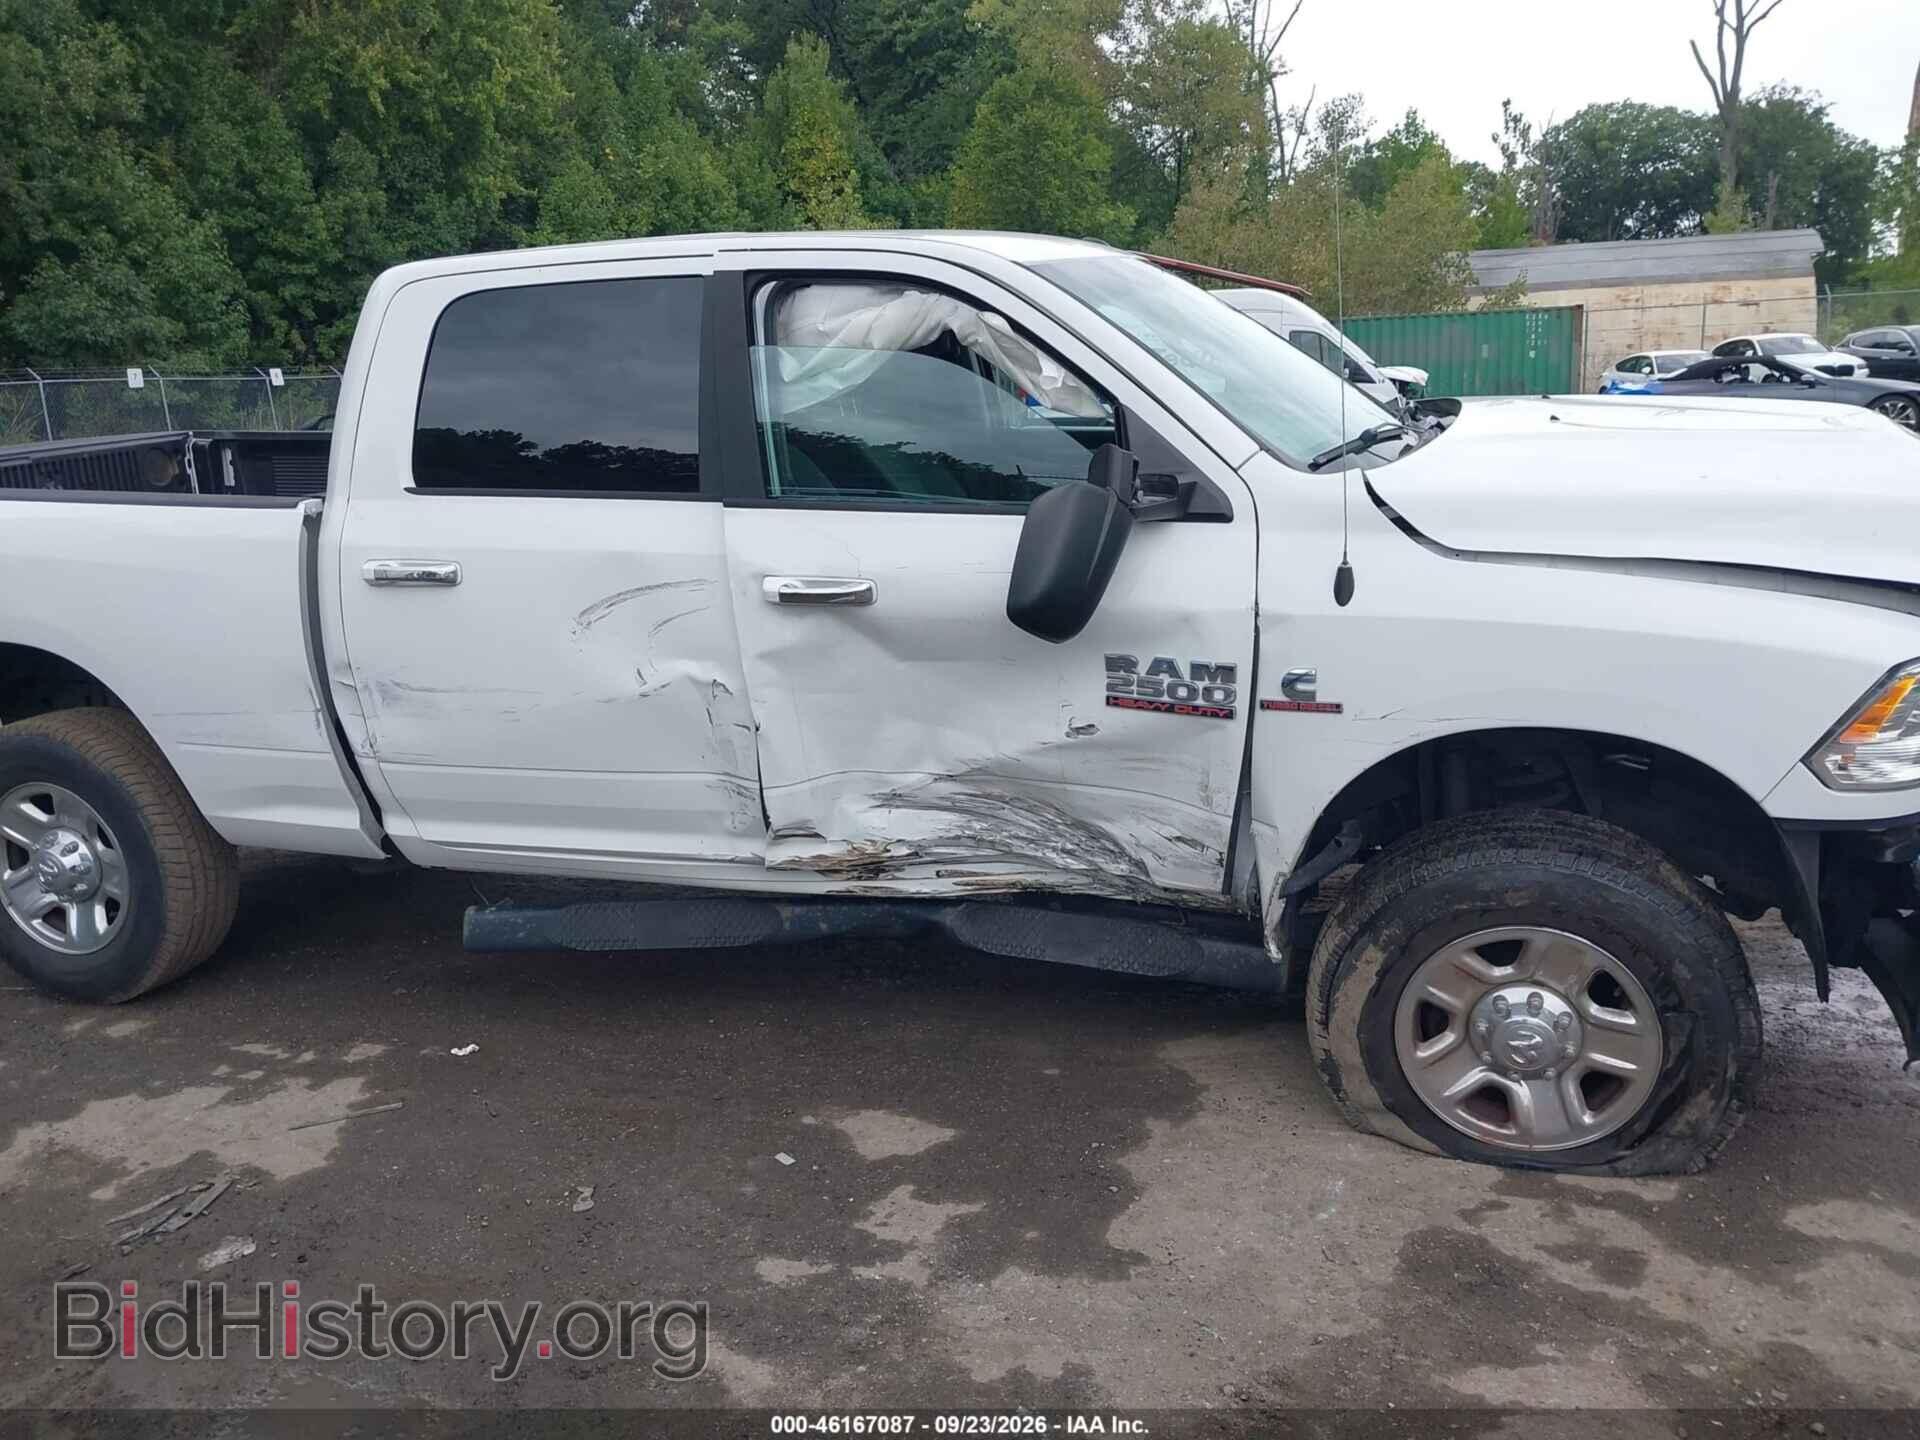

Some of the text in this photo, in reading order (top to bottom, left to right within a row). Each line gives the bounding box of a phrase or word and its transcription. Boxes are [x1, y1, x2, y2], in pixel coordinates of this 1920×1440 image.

[1104, 653, 1237, 684] RAM
[1106, 673, 1237, 705] 2500
[1110, 697, 1230, 717] HEAVY DUTY
